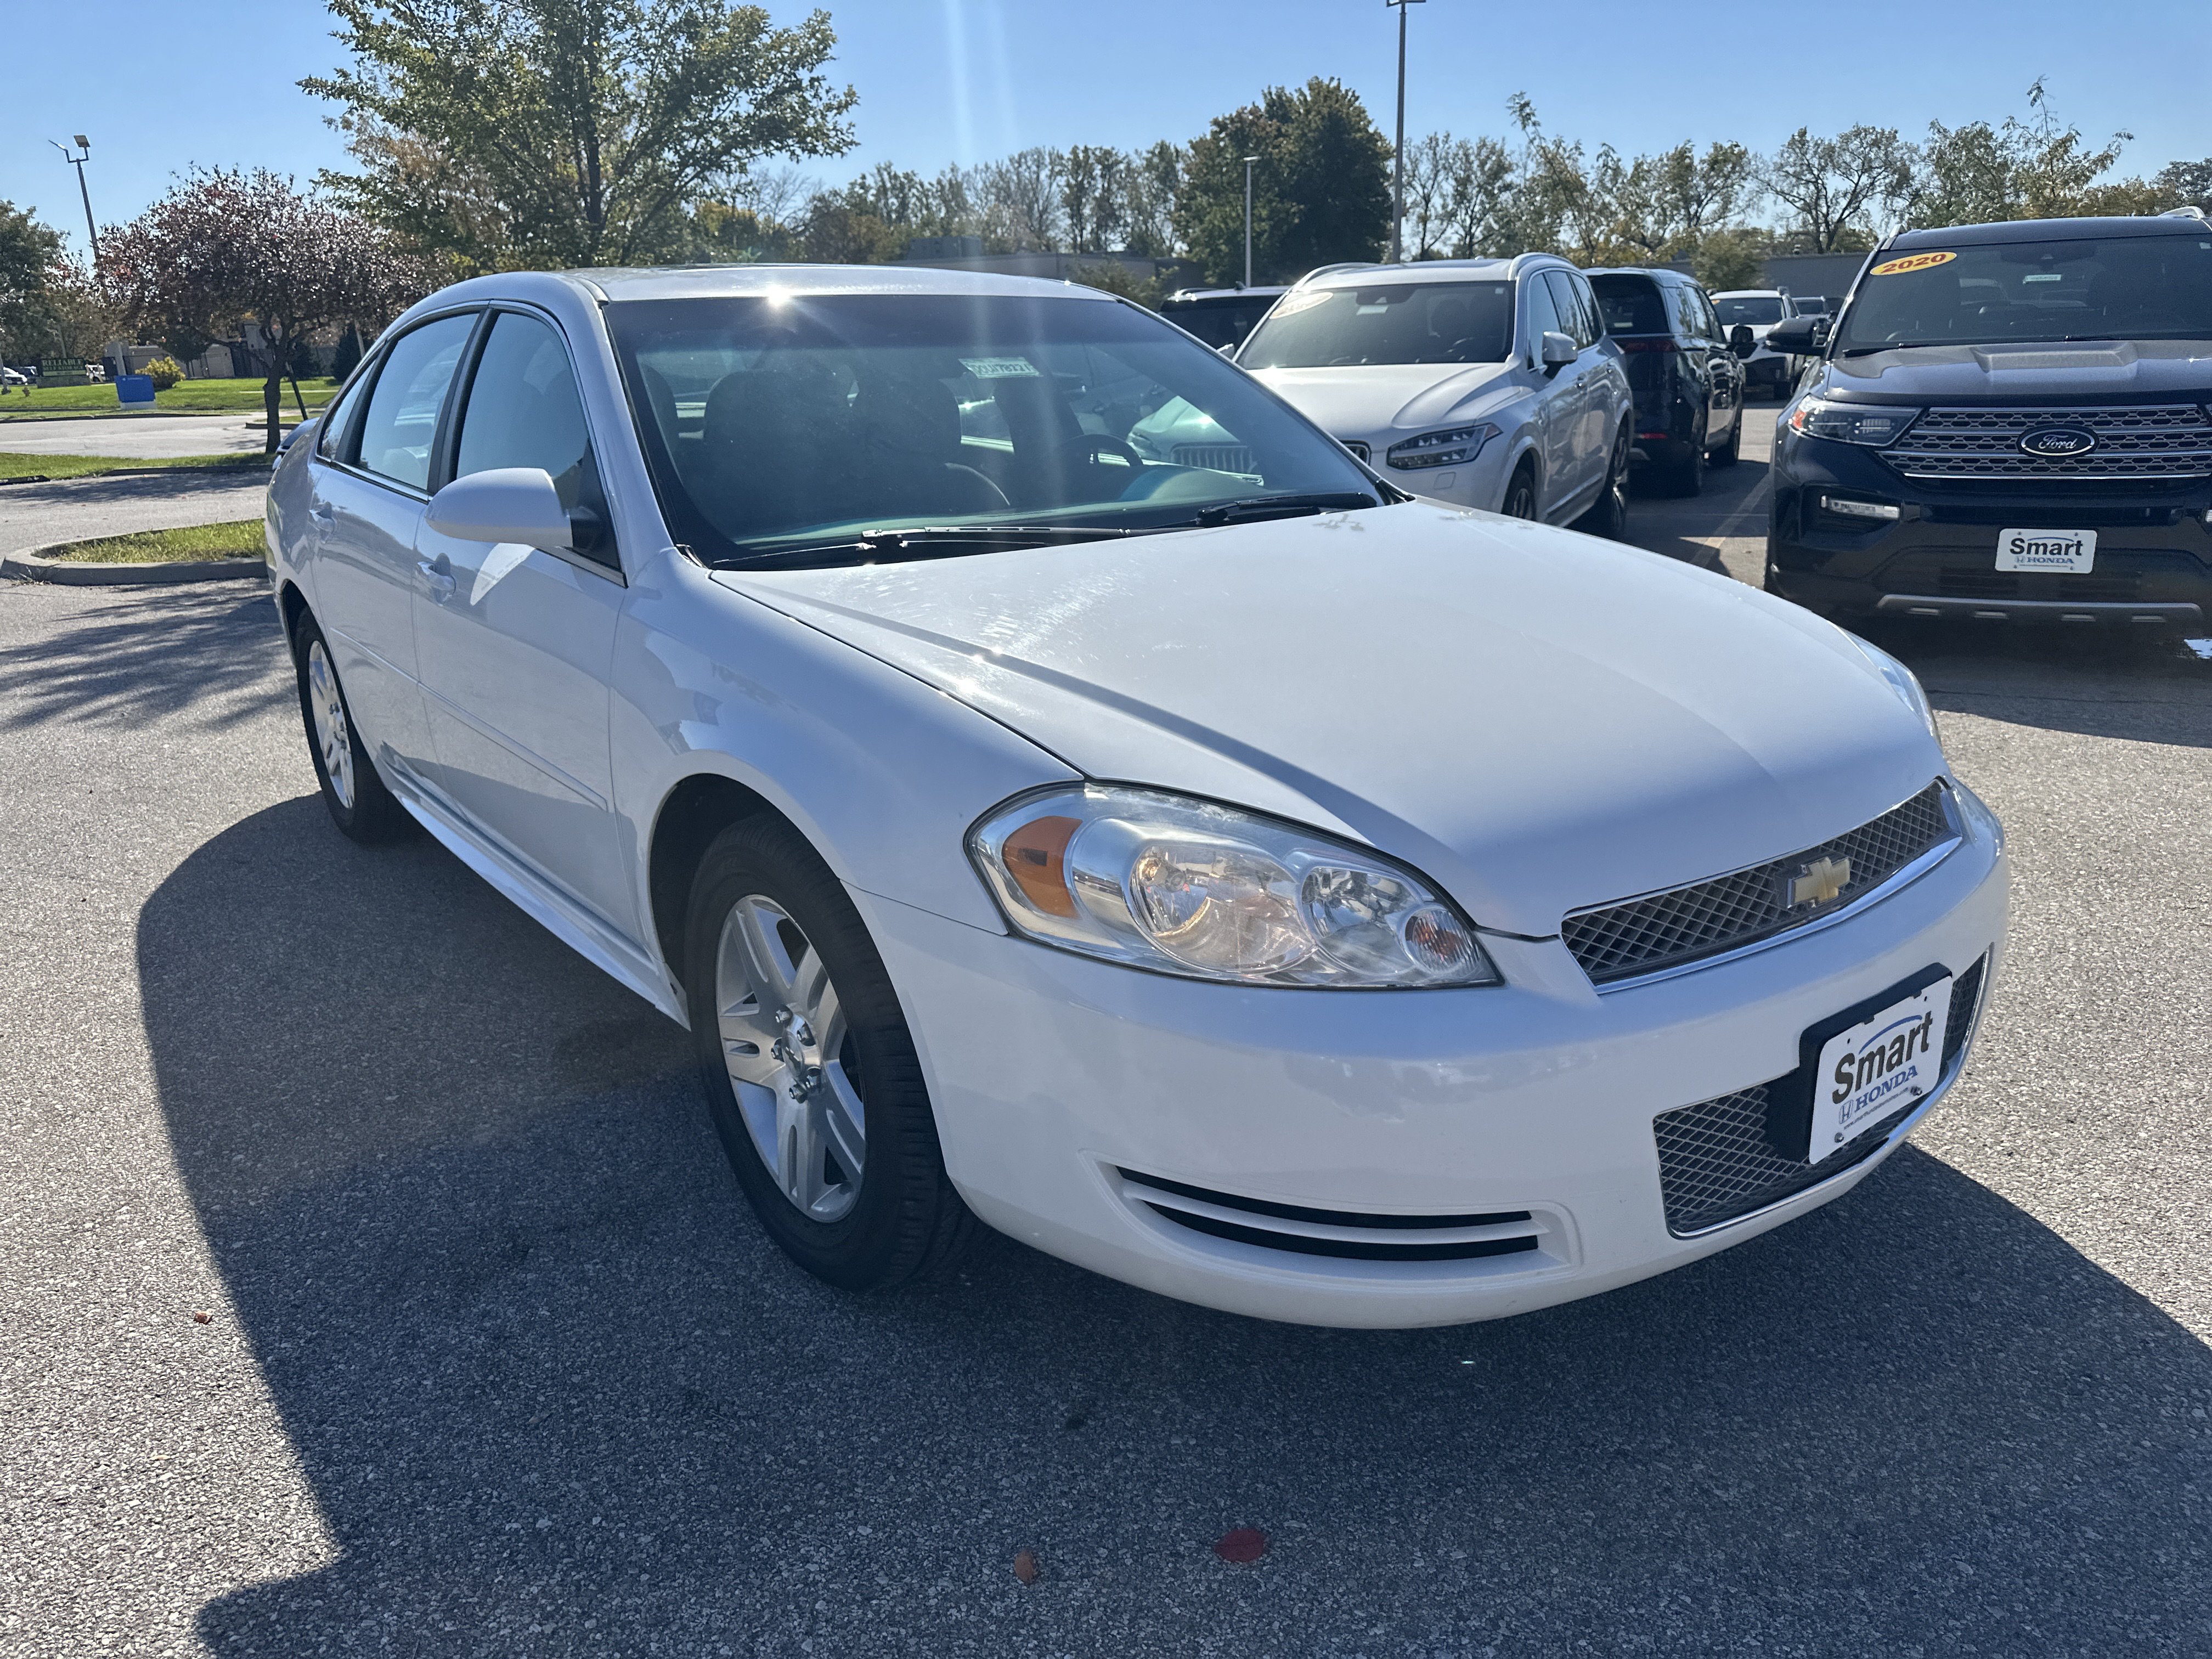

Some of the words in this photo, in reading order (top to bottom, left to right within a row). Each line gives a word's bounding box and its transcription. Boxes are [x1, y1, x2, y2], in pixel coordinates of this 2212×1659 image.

[1882, 253, 1946, 273] 2020
[2038, 434, 2078, 449] Ford
[2009, 537, 2083, 556] Smart
[1832, 1011, 1933, 1104] Smart
[1854, 1065, 1917, 1113] HONDA
